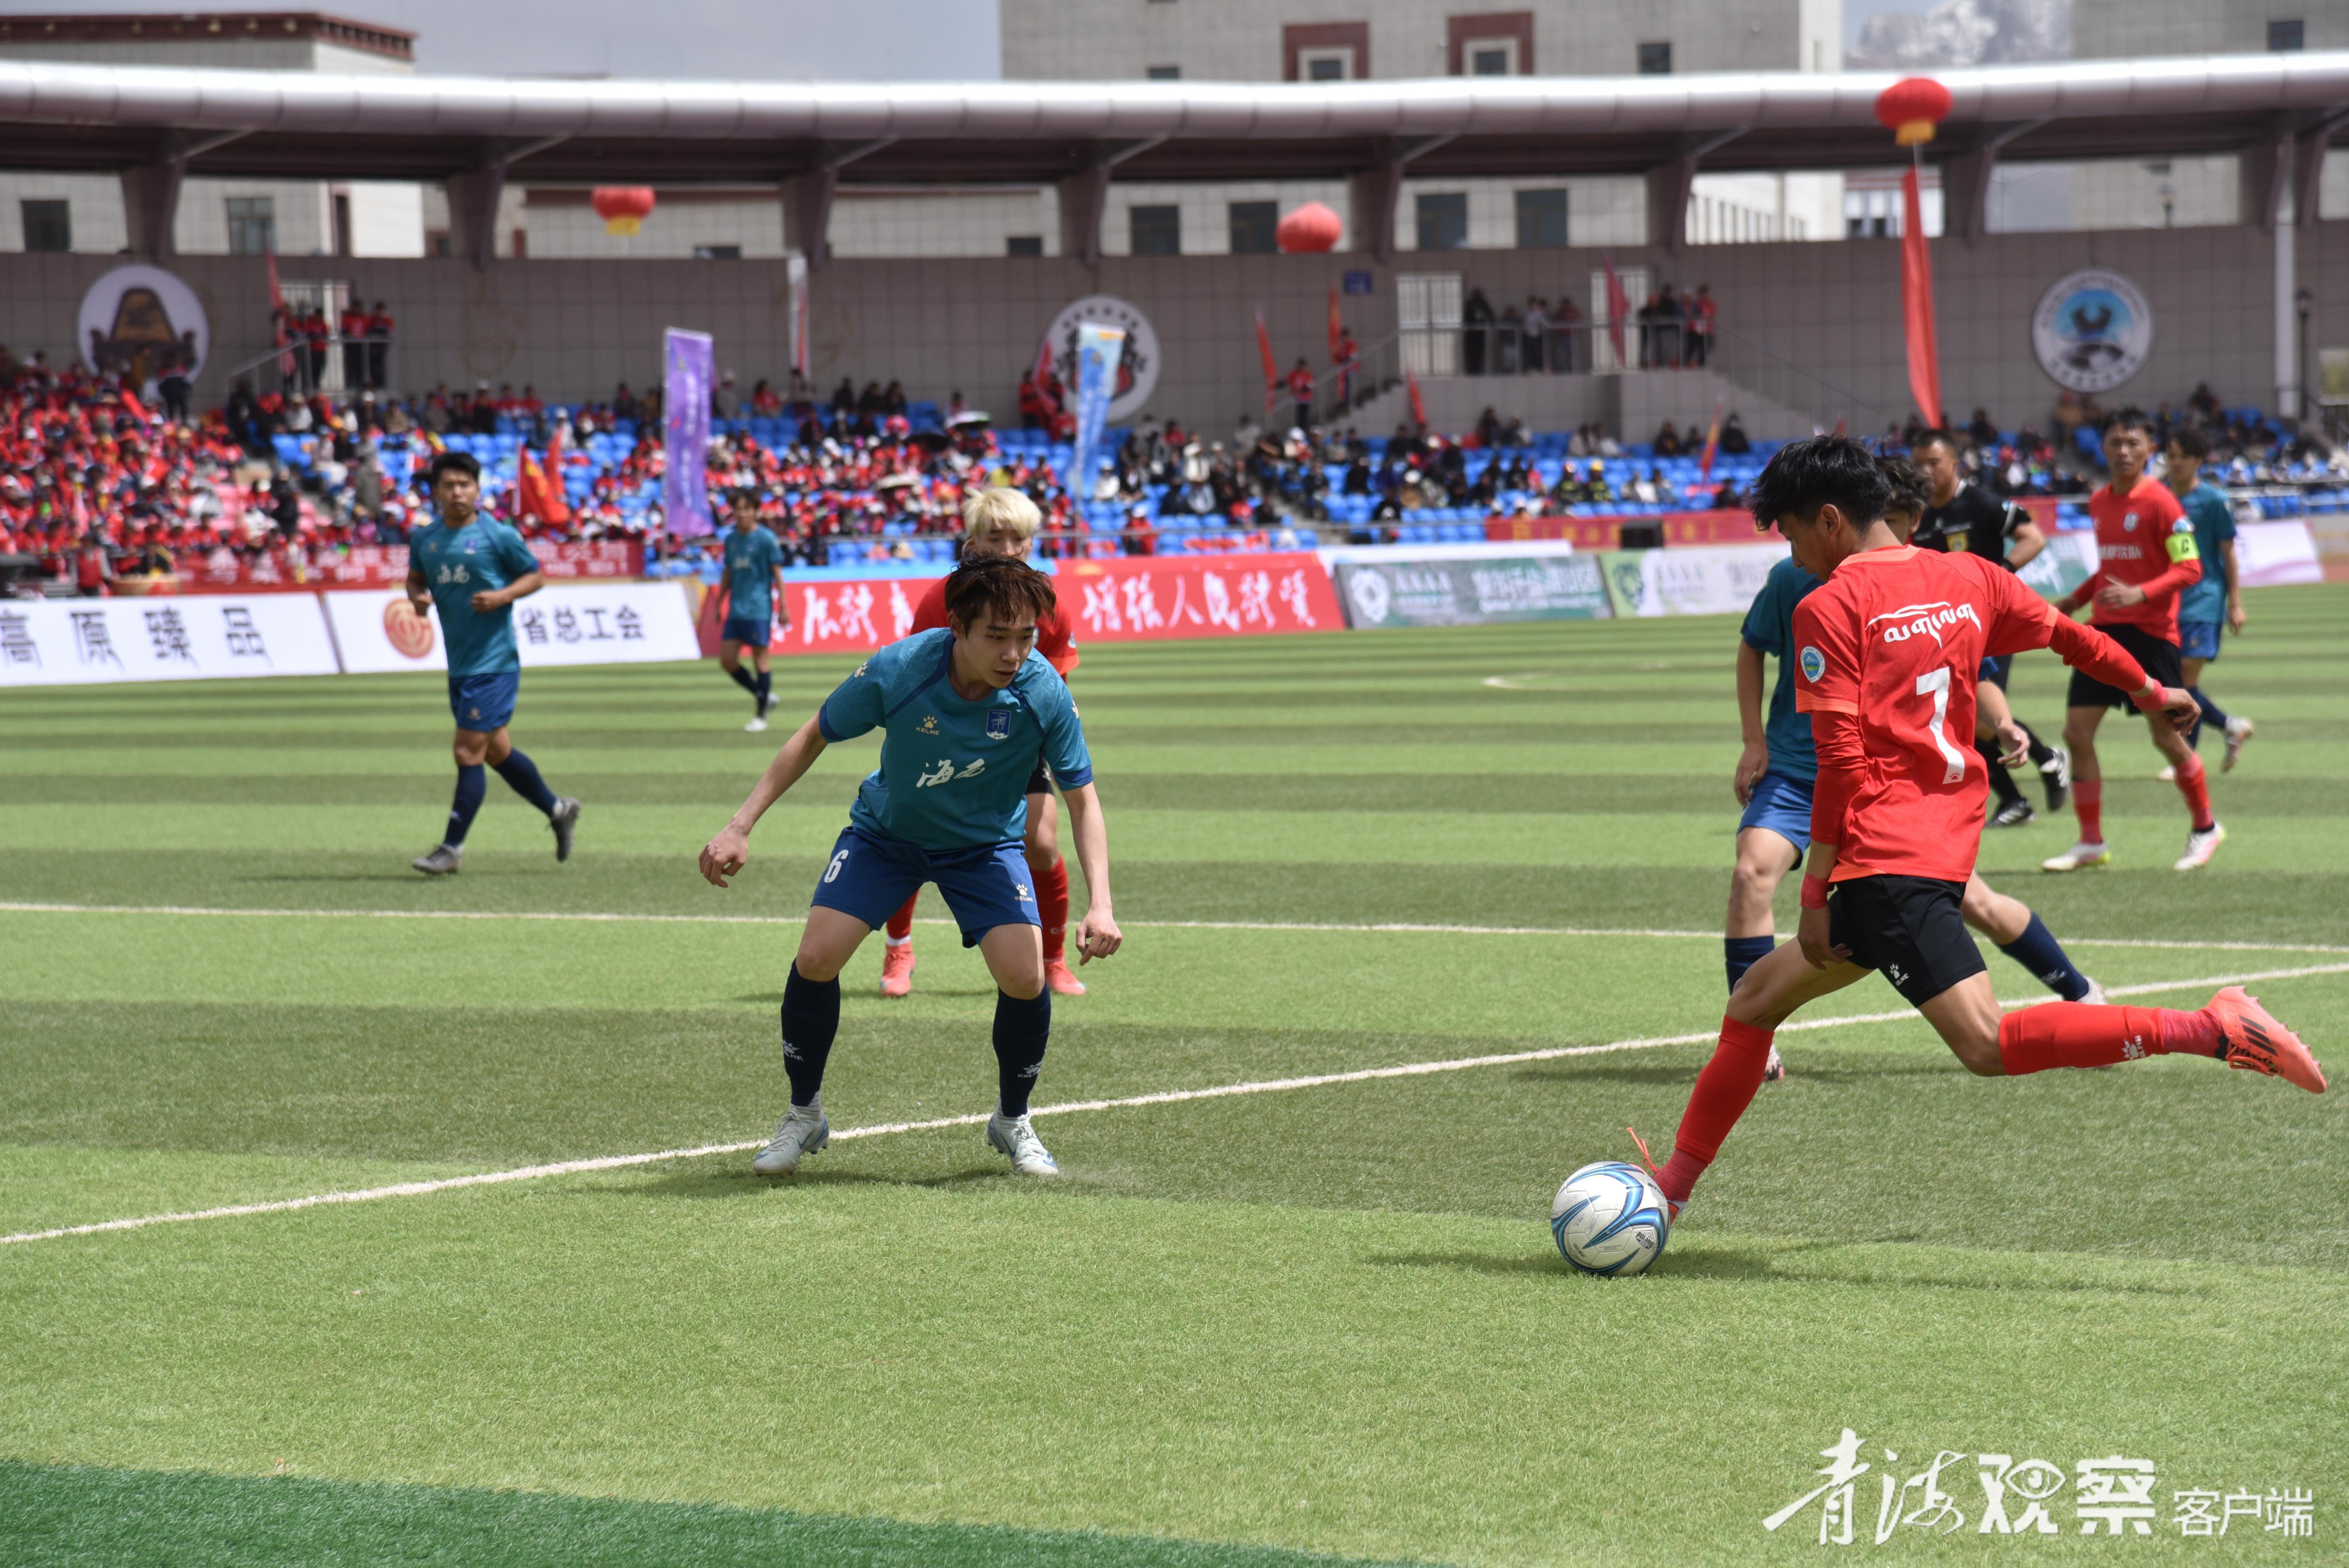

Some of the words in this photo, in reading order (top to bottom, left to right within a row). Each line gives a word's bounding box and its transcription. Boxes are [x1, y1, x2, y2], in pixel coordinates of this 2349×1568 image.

[916, 727, 940, 736] KELME
[1916, 666, 1965, 784] 7
[823, 849, 849, 883] 6
[1635, 1231, 1654, 1249] POLARIS
